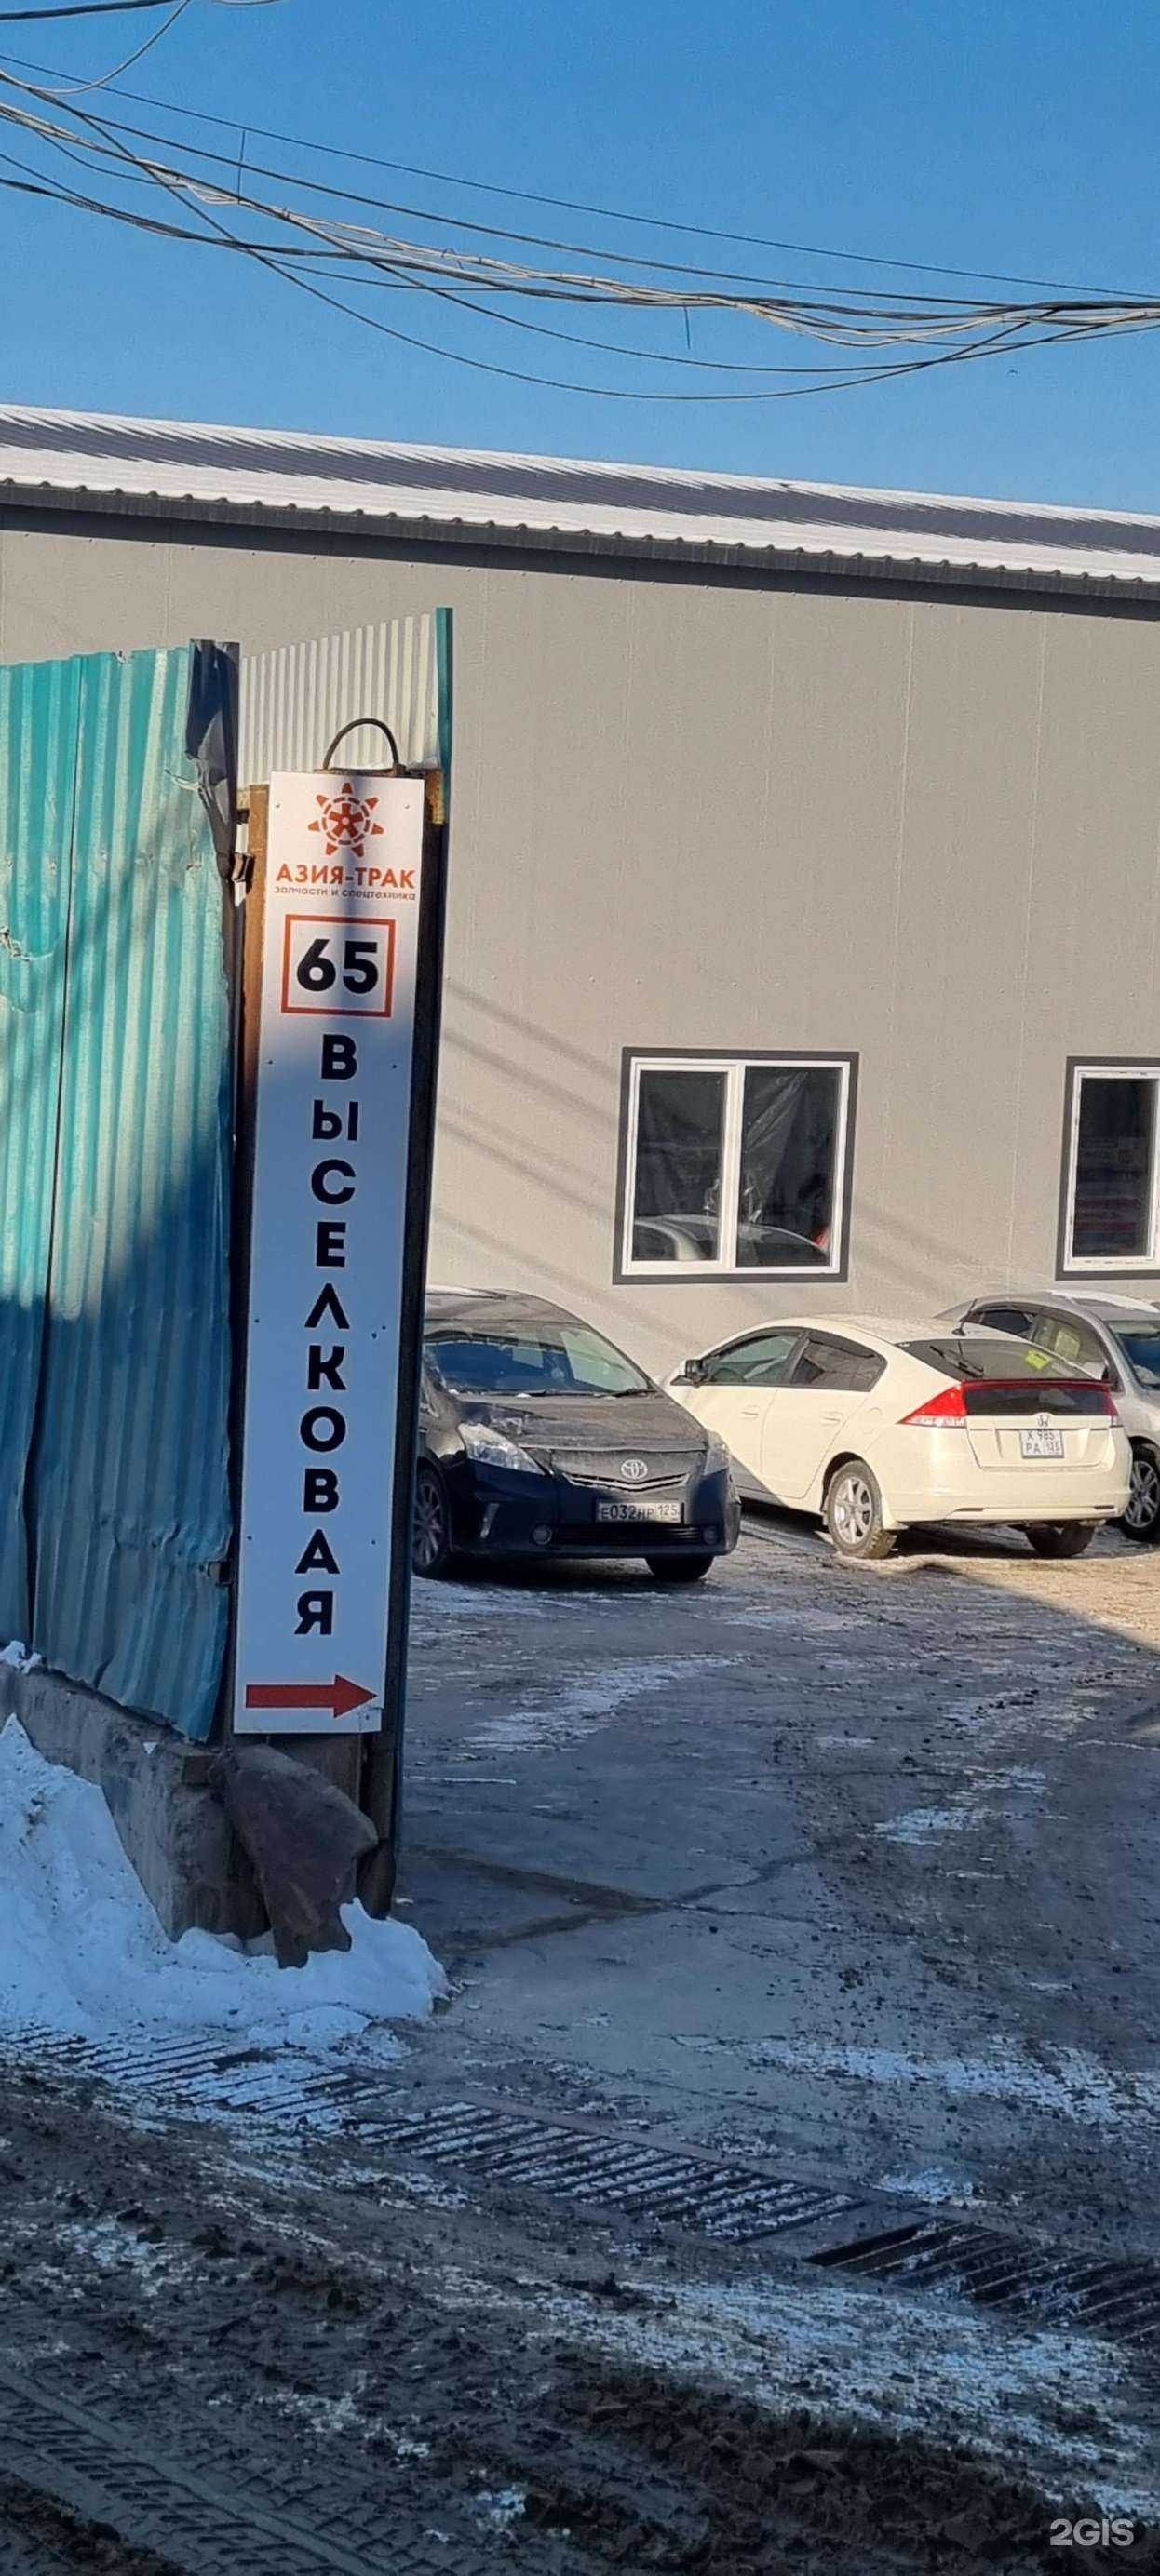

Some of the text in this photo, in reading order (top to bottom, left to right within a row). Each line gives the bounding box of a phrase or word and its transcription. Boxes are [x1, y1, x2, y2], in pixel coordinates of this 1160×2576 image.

[276, 863, 416, 889] АЗИЯ-ТРАК
[296, 938, 379, 994] 65
[293, 1033, 359, 1636] ВЫСЕЛКОВАЯ
